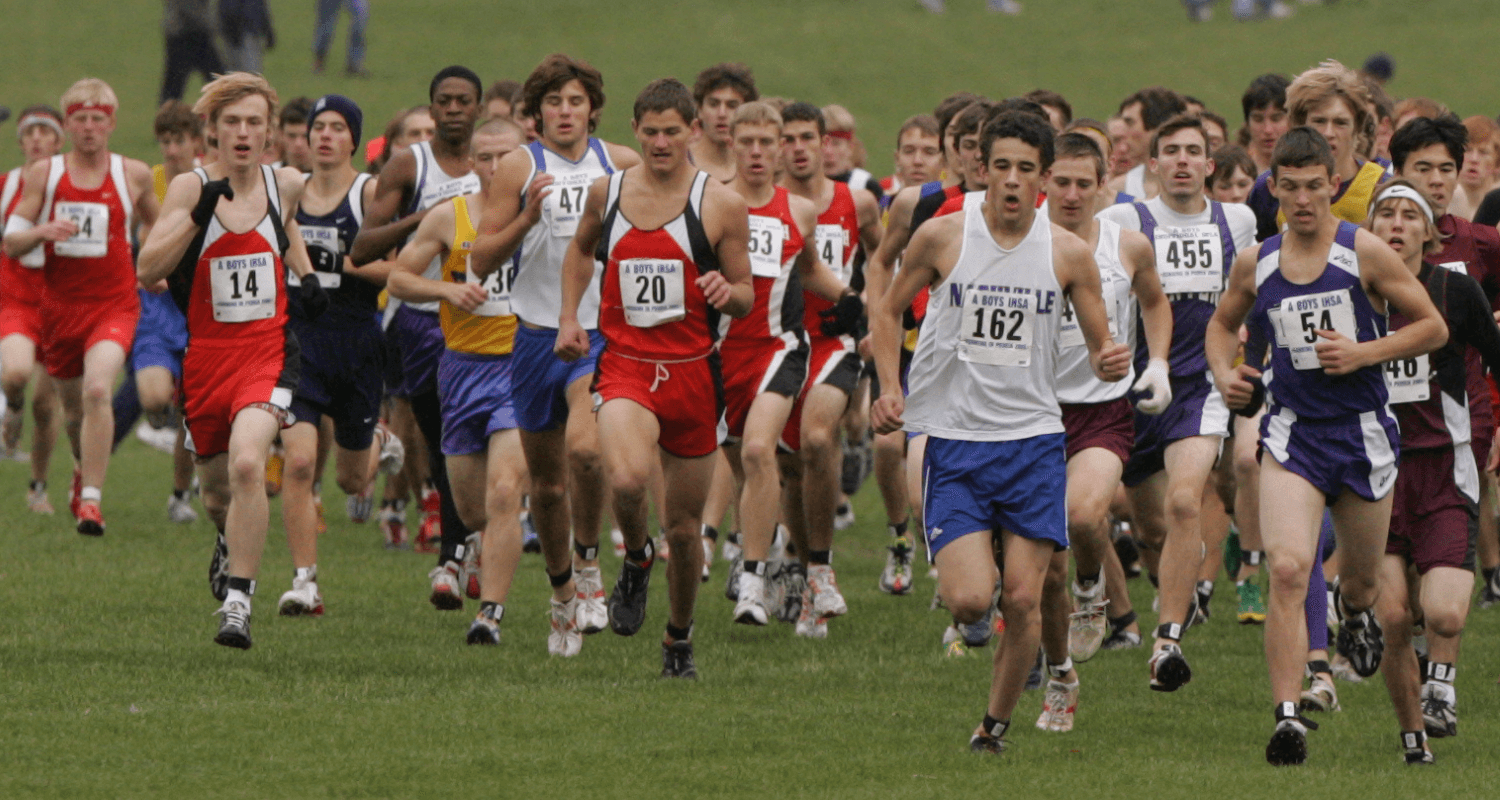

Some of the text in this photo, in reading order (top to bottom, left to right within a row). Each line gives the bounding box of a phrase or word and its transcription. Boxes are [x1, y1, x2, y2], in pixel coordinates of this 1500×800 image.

[226, 259, 247, 270] BOYS
[633, 264, 654, 274] BOYS
[1166, 239, 1213, 270] 455
[229, 269, 259, 299] 14
[635, 275, 666, 305] 20
[972, 294, 1029, 309] A BOYS IHSA
[1288, 295, 1343, 312] A BOYS IHSA
[972, 307, 1024, 341] 162
[1300, 309, 1336, 344] 54
